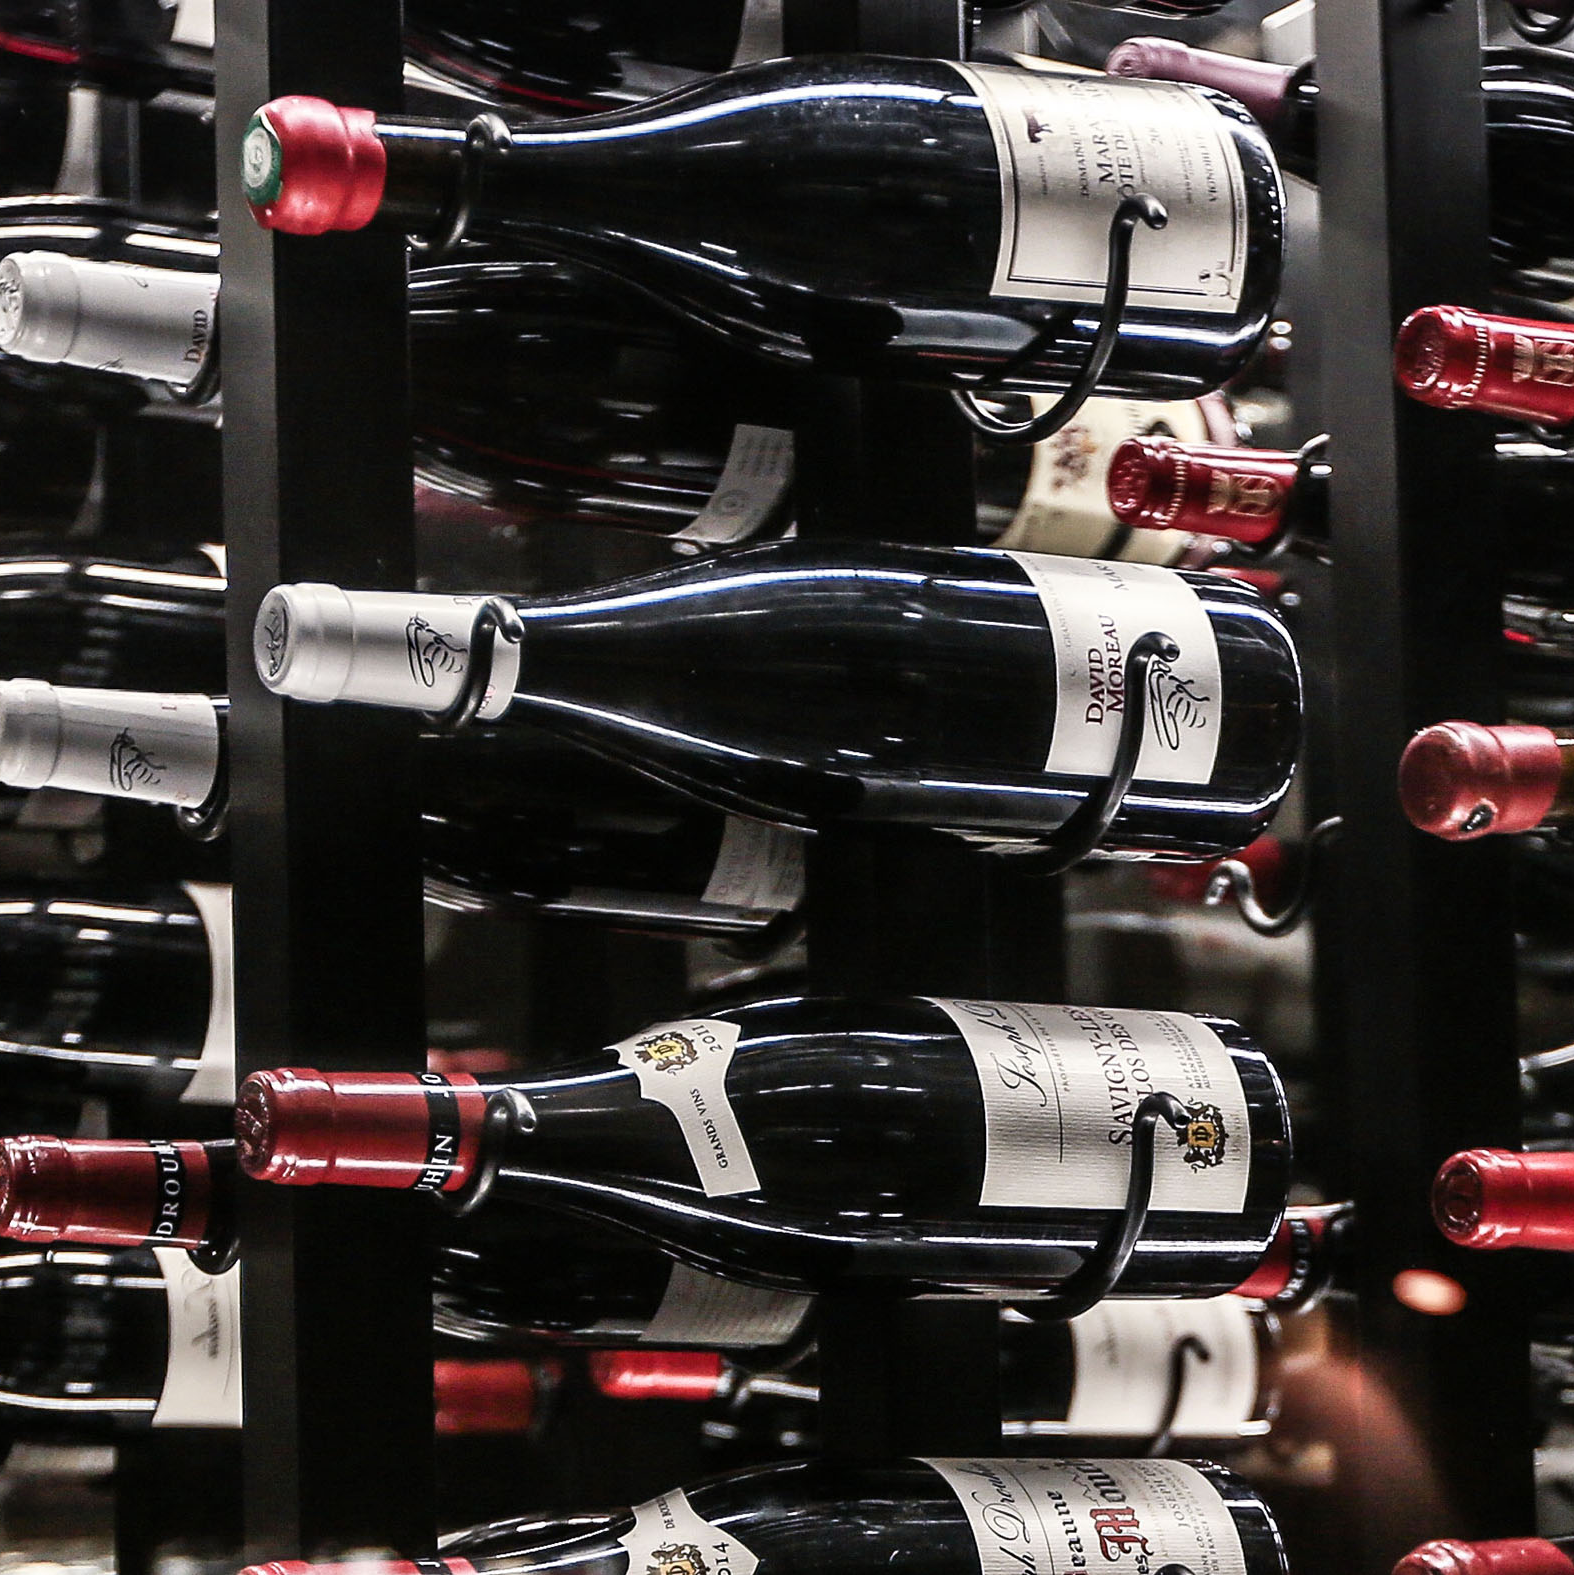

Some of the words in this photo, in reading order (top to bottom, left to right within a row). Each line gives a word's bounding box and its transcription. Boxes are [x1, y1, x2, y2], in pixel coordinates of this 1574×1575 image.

[1118, 155, 1135, 199] ÔTE
[182, 307, 208, 363] DAVID
[1085, 648, 1105, 725] DAVID
[1098, 613, 1124, 713] MOREAU
[692, 1023, 723, 1053] 2011
[990, 1018, 1048, 1108] Joseph
[689, 1088, 708, 1115] VINS
[703, 1119, 730, 1169] GRANDS
[663, 1518, 676, 1529] DE
[1155, 1480, 1189, 1527] JOSEPH
